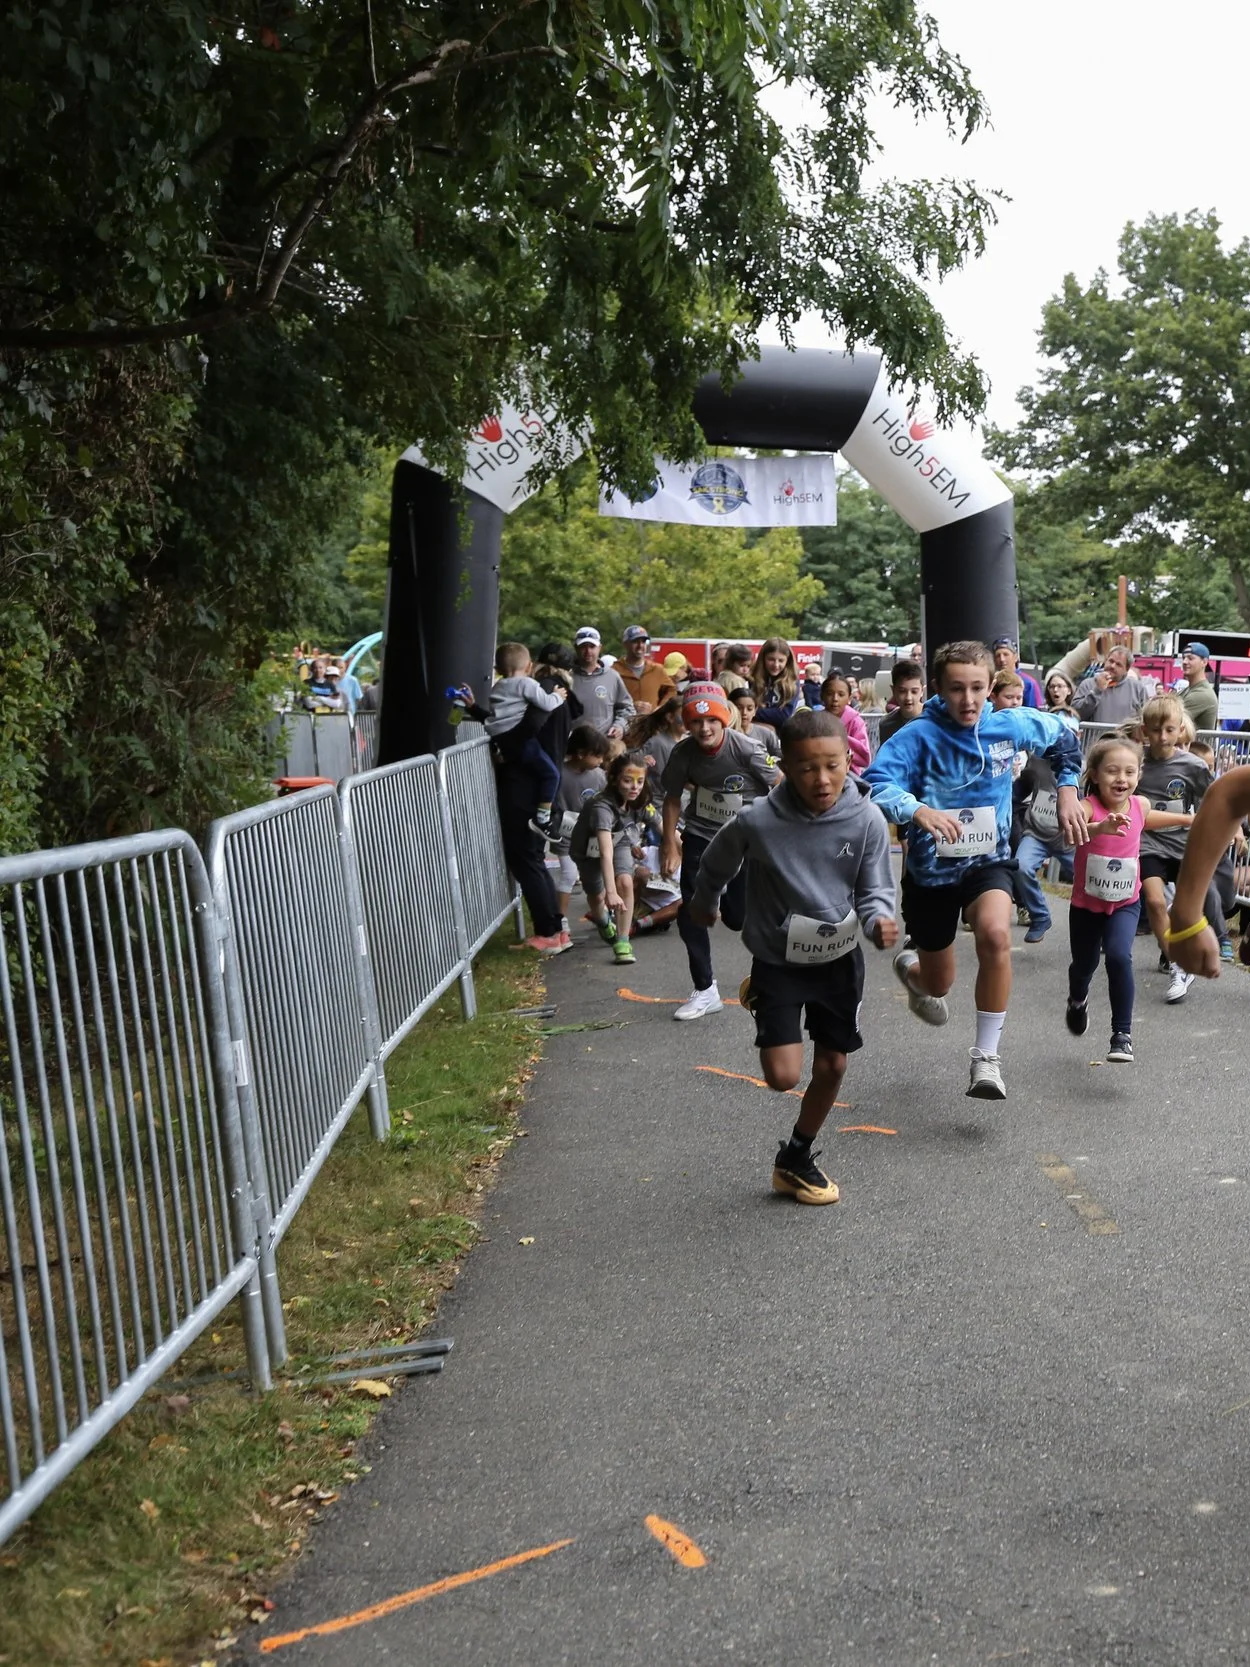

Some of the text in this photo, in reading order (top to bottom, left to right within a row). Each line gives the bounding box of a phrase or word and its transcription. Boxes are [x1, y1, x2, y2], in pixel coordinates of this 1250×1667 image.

[471, 400, 558, 481] High5E
[872, 408, 971, 509] High5EM
[773, 493, 823, 506] High5EM
[699, 802, 717, 814] FUN
[941, 832, 993, 845] FN RUN
[1089, 876, 1133, 890] FUN RUN
[793, 934, 855, 953] FUN RUN
